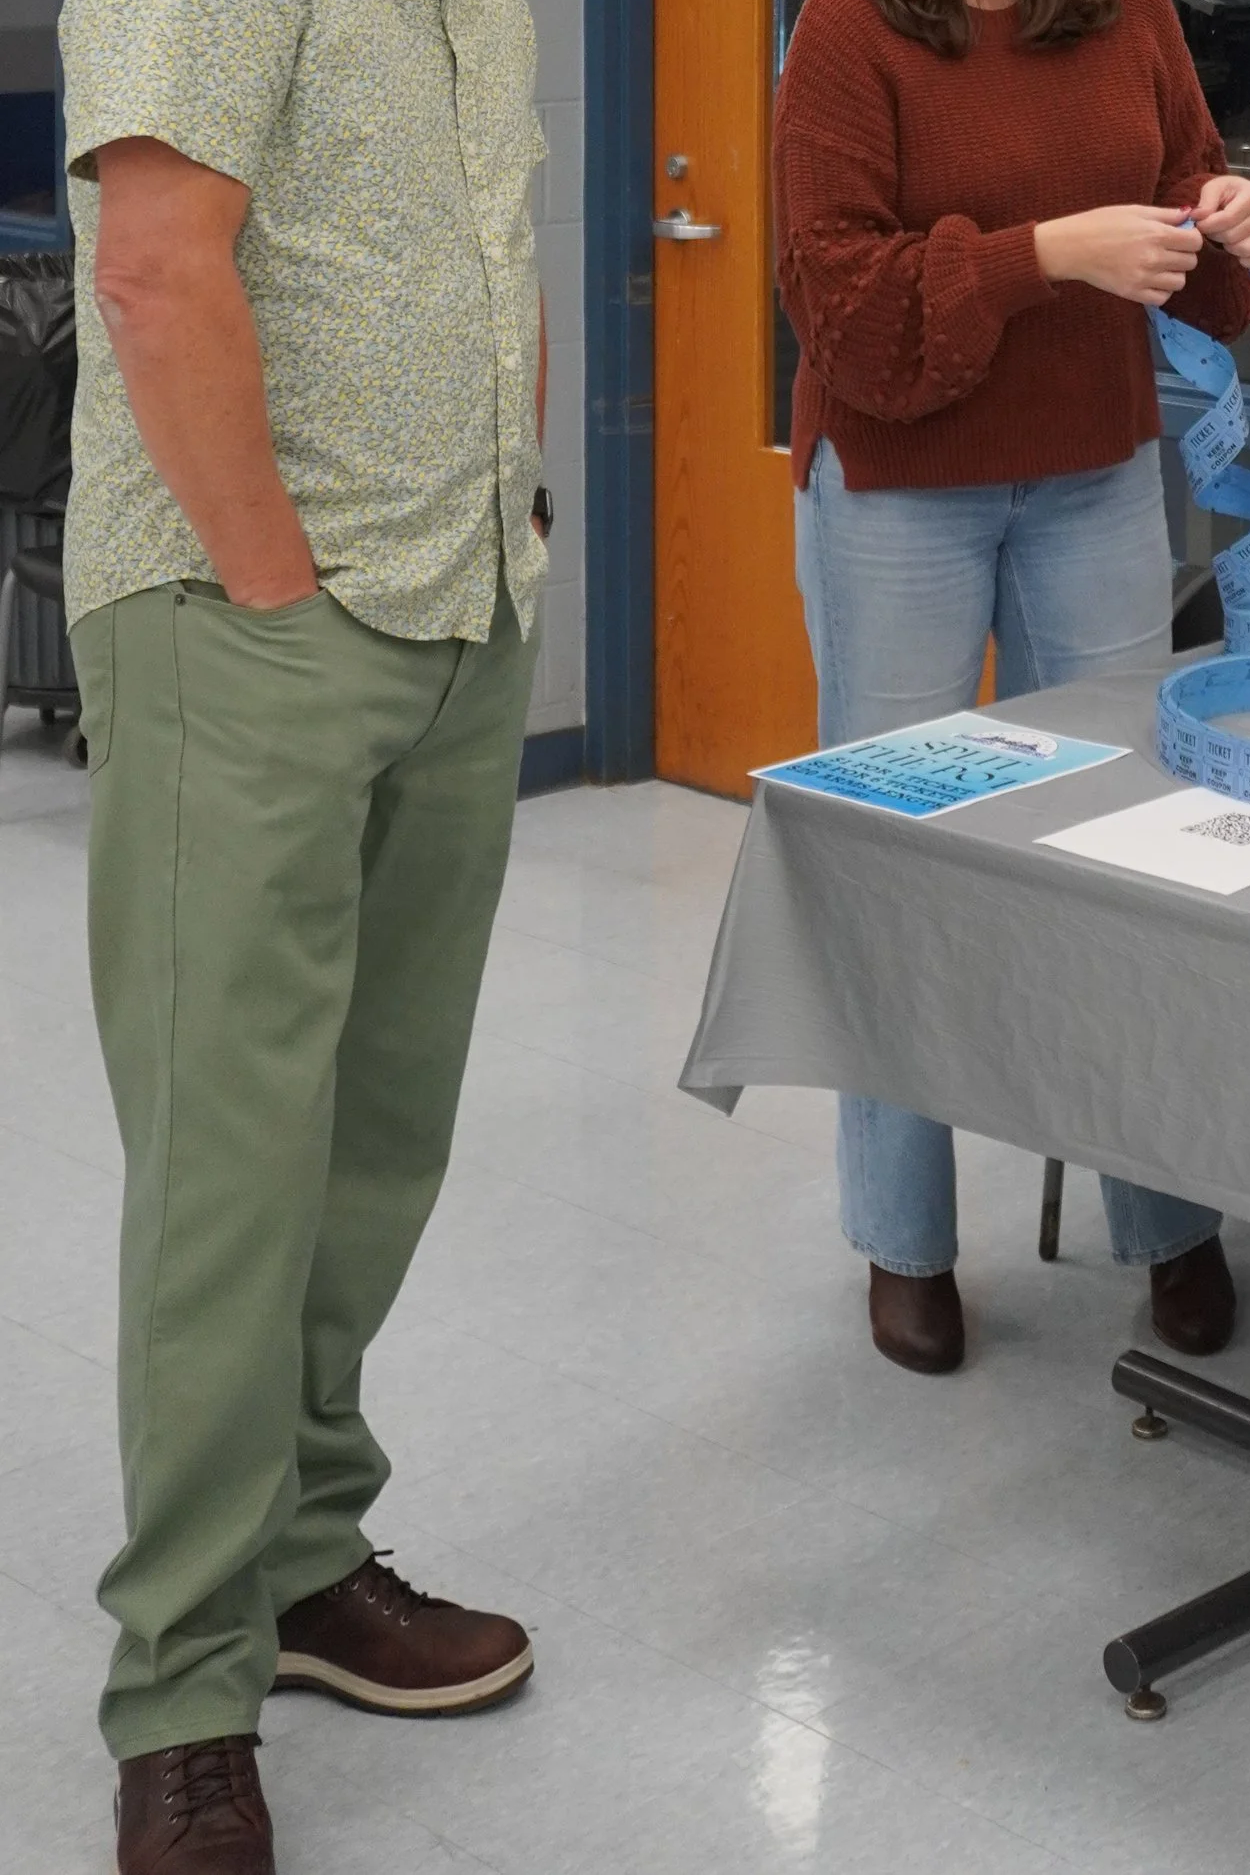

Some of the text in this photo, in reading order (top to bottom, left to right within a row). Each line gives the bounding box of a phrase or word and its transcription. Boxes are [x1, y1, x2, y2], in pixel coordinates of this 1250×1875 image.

[1190, 422, 1216, 449] TICKET
[1207, 440, 1226, 459] KEEP
[1211, 442, 1237, 470] COUPON
[1177, 729, 1197, 748] TICKET
[1208, 741, 1232, 760] TICKET
